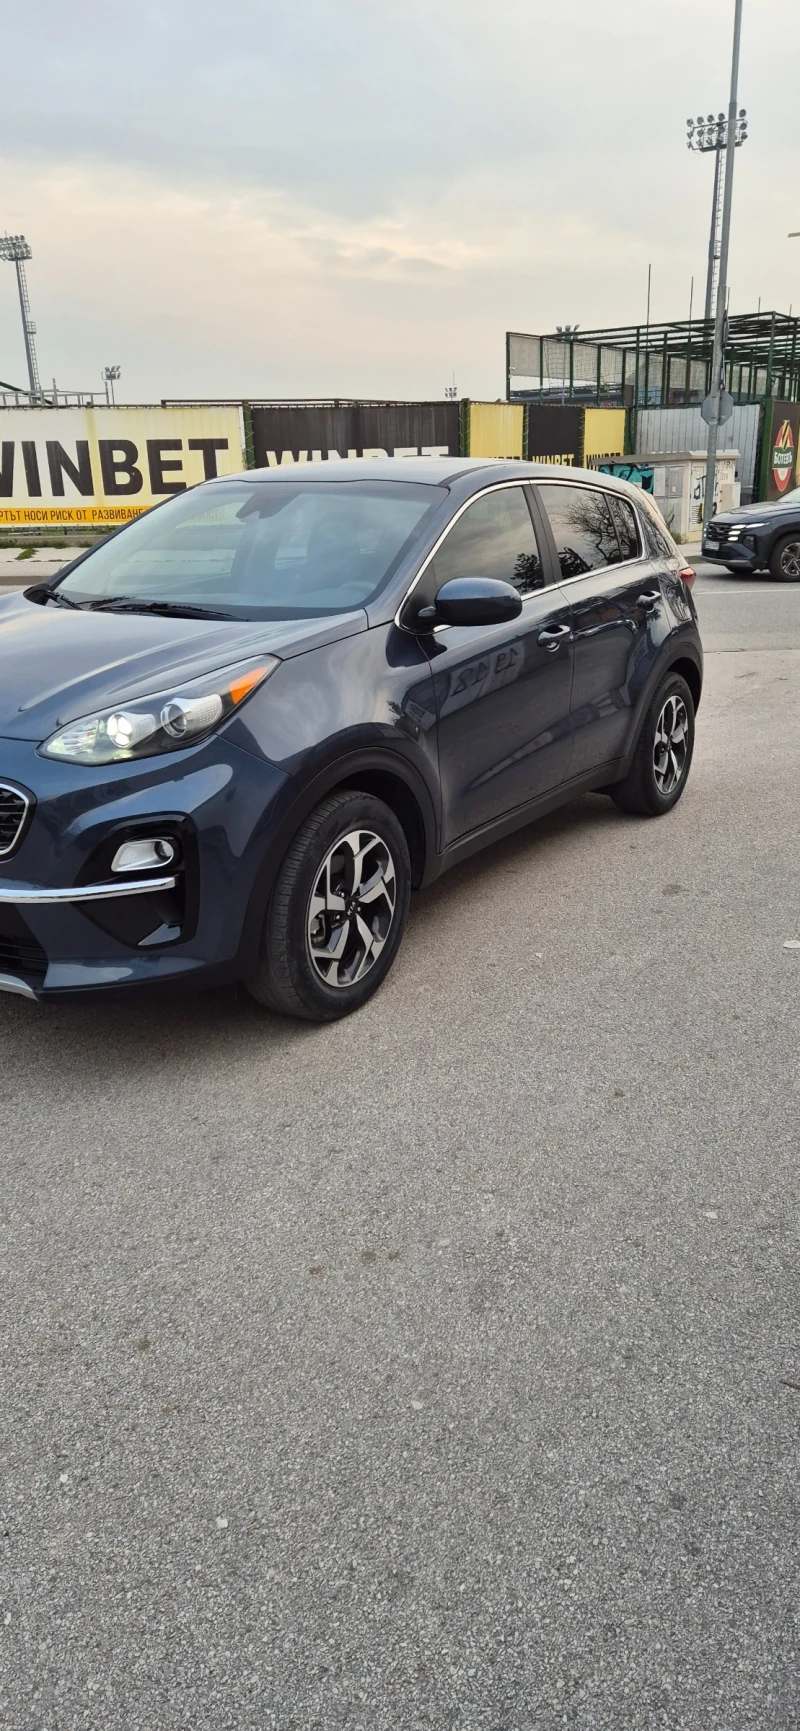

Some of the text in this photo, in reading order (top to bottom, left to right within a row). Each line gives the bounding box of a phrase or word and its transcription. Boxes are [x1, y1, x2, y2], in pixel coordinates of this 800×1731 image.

[0, 438, 229, 497] INBET
[24, 510, 48, 521] НОСИ
[50, 510, 74, 521] РИСК
[76, 509, 87, 520] ОТ
[346, 901, 356, 916] KIA
